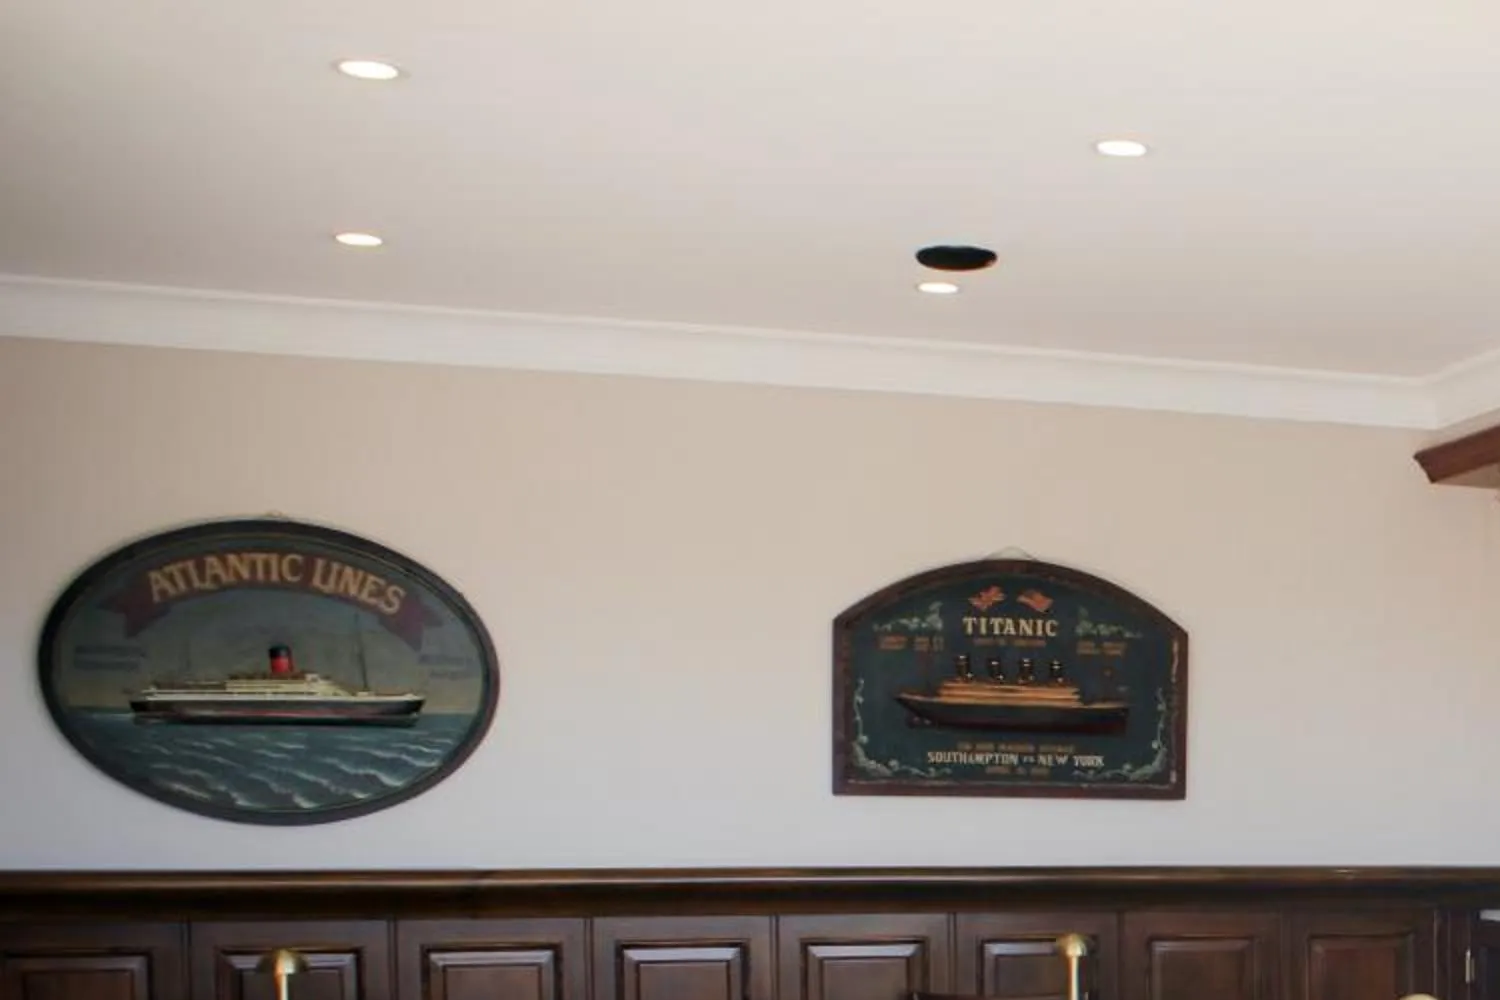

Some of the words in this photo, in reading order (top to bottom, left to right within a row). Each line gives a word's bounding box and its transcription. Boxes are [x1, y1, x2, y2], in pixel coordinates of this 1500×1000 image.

[147, 552, 305, 602] ATLANTIC
[311, 557, 407, 616] LINES
[962, 615, 1060, 637] TITANIC
